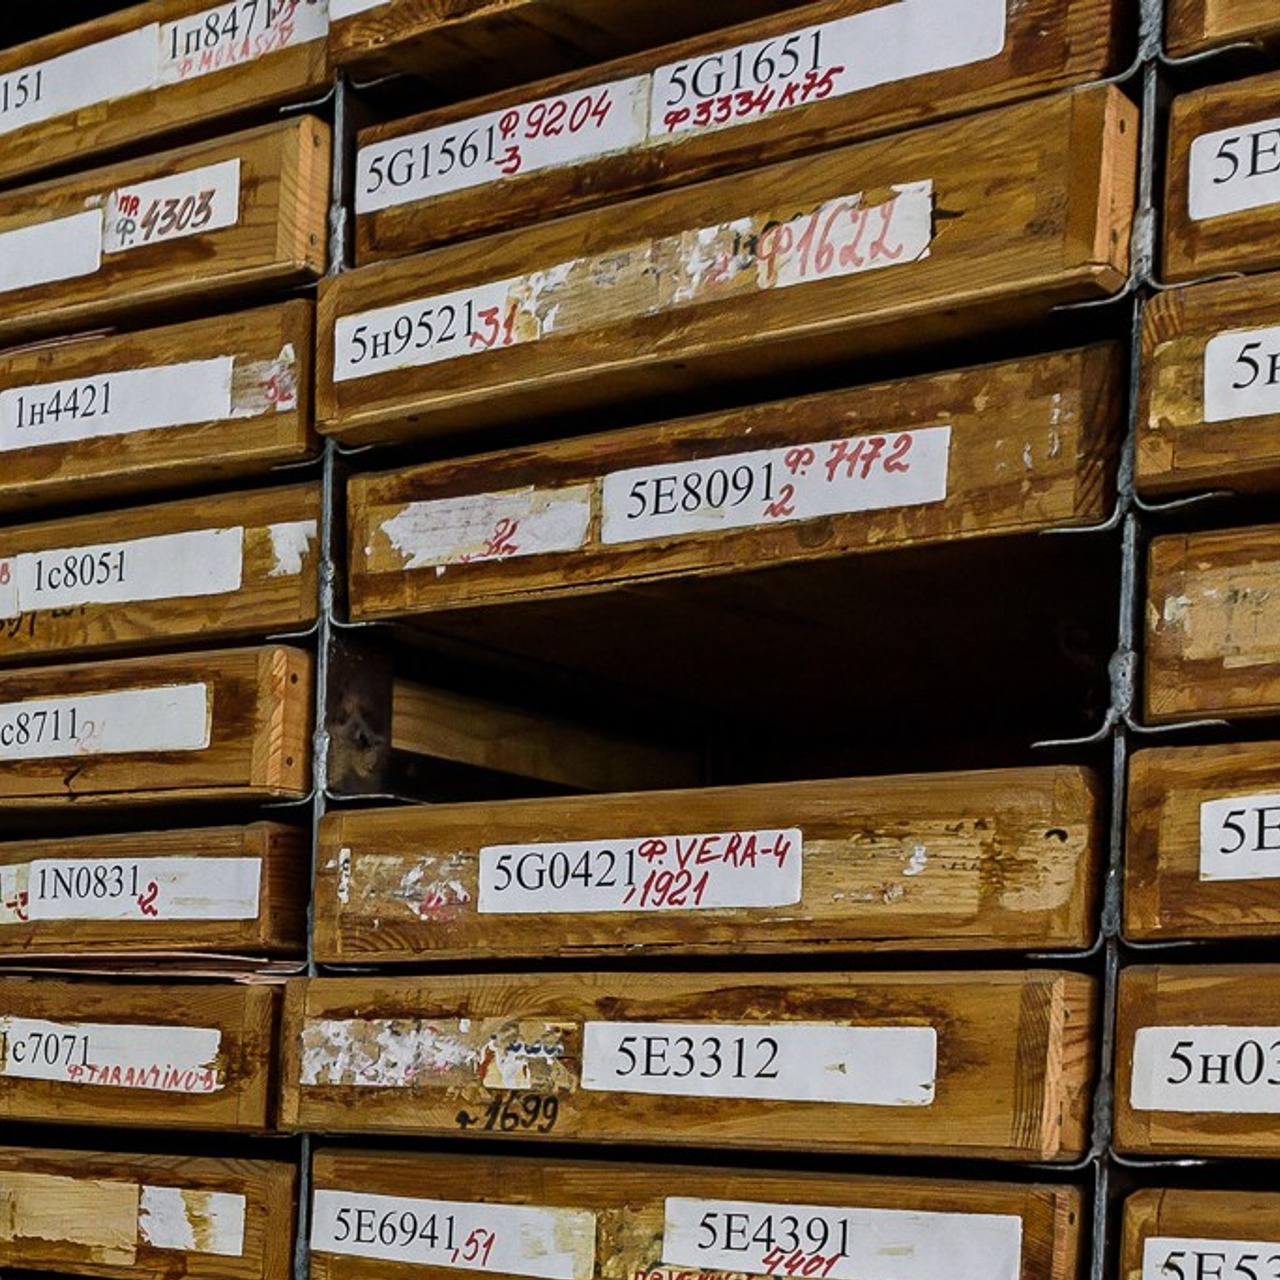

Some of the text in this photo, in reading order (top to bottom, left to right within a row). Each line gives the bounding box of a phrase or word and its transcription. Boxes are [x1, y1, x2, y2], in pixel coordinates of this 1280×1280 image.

[667, 32, 820, 105] 5G1651
[367, 123, 499, 193] 5G1561
[351, 300, 472, 363] 5н9521
[14, 382, 109, 427] 1н4421
[627, 462, 772, 518] 5E8091
[40, 865, 137, 898] 1N0831
[494, 849, 634, 890] 5G0421
[2, 1031, 92, 1070] 1c7071
[616, 1037, 778, 1078] 5E3312
[334, 1208, 453, 1250] 5E6941
[698, 1213, 849, 1257] 5E4391
